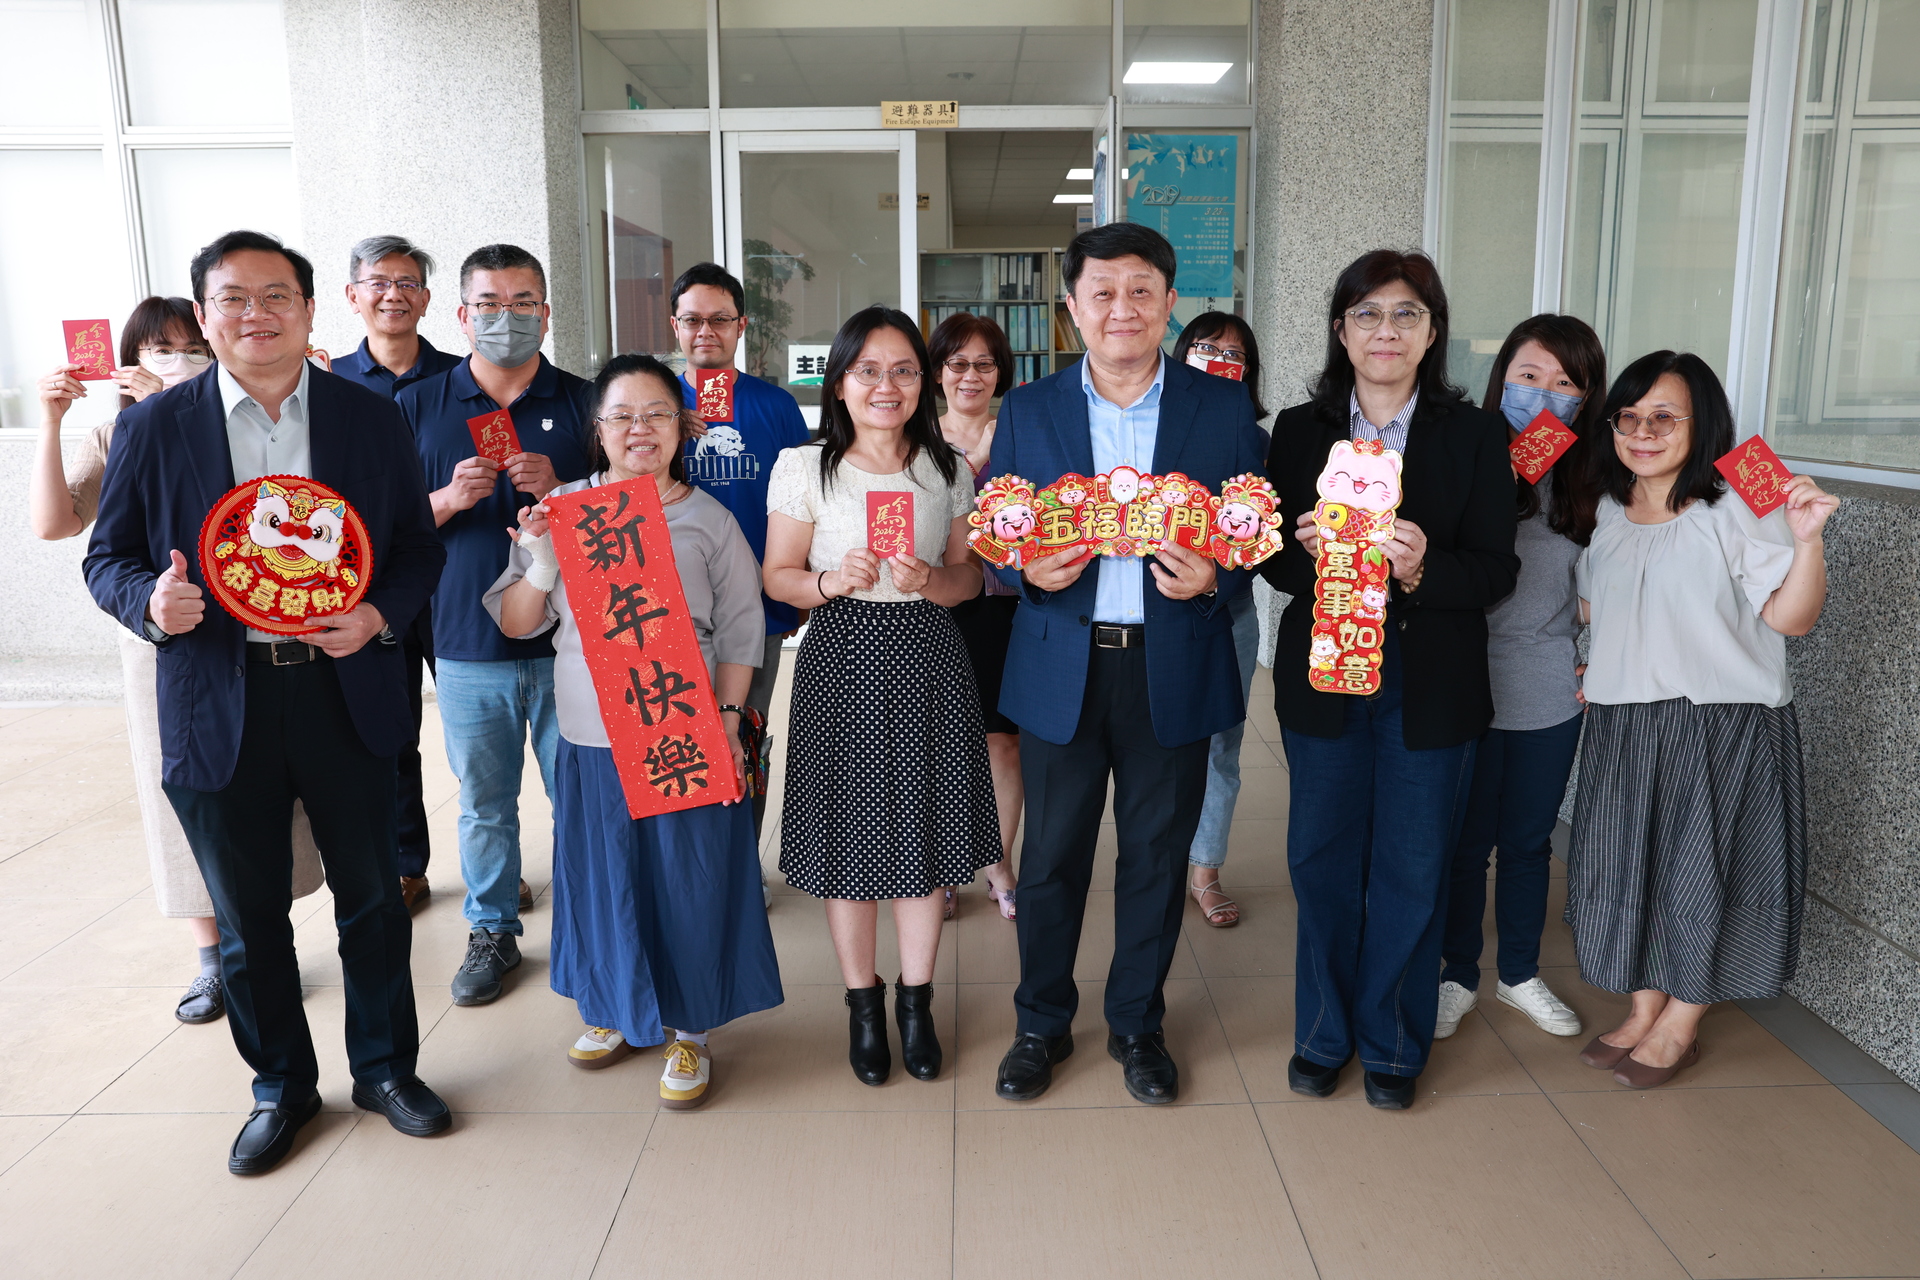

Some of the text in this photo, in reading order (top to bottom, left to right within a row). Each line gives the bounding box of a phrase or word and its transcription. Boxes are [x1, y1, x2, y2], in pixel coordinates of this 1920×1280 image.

[892, 103, 949, 117] 避難器具
[900, 118, 921, 126] Escape
[922, 117, 956, 126] Equipment
[74, 351, 96, 361] 2026
[701, 395, 719, 404] 2026
[484, 441, 503, 456] 2026
[1520, 439, 1541, 455] 2026
[683, 453, 757, 482] PUMA
[1746, 475, 1768, 496] 2026
[873, 526, 895, 537] 2026
[1039, 500, 1210, 548] 五福臨門
[221, 560, 347, 618] 恭喜發財
[1319, 541, 1377, 692] 萬事如意
[574, 490, 710, 798] 新年快樂
